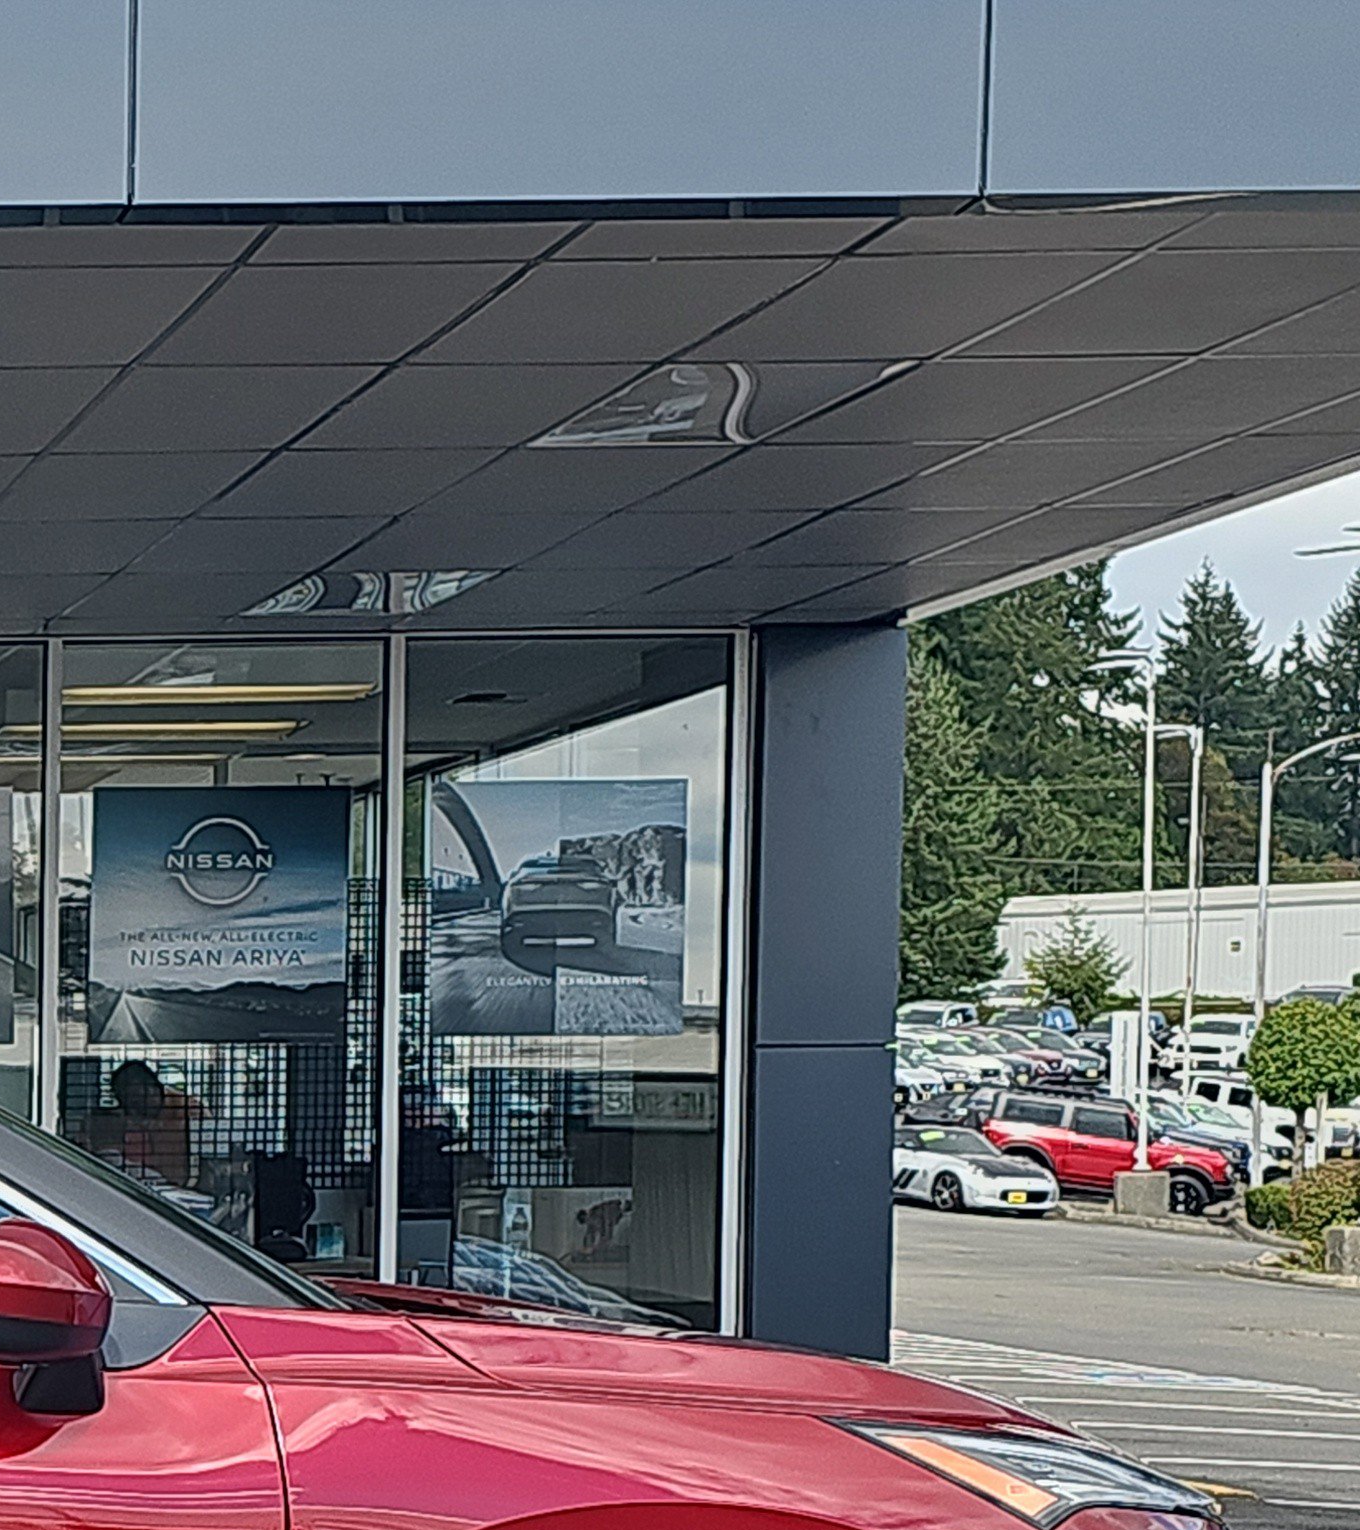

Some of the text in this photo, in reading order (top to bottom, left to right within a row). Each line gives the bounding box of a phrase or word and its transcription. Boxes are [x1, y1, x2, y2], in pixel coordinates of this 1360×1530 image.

[167, 854, 273, 869] NISSAN
[120, 931, 145, 941] THE
[130, 949, 306, 966] NISSAN ARIYA
